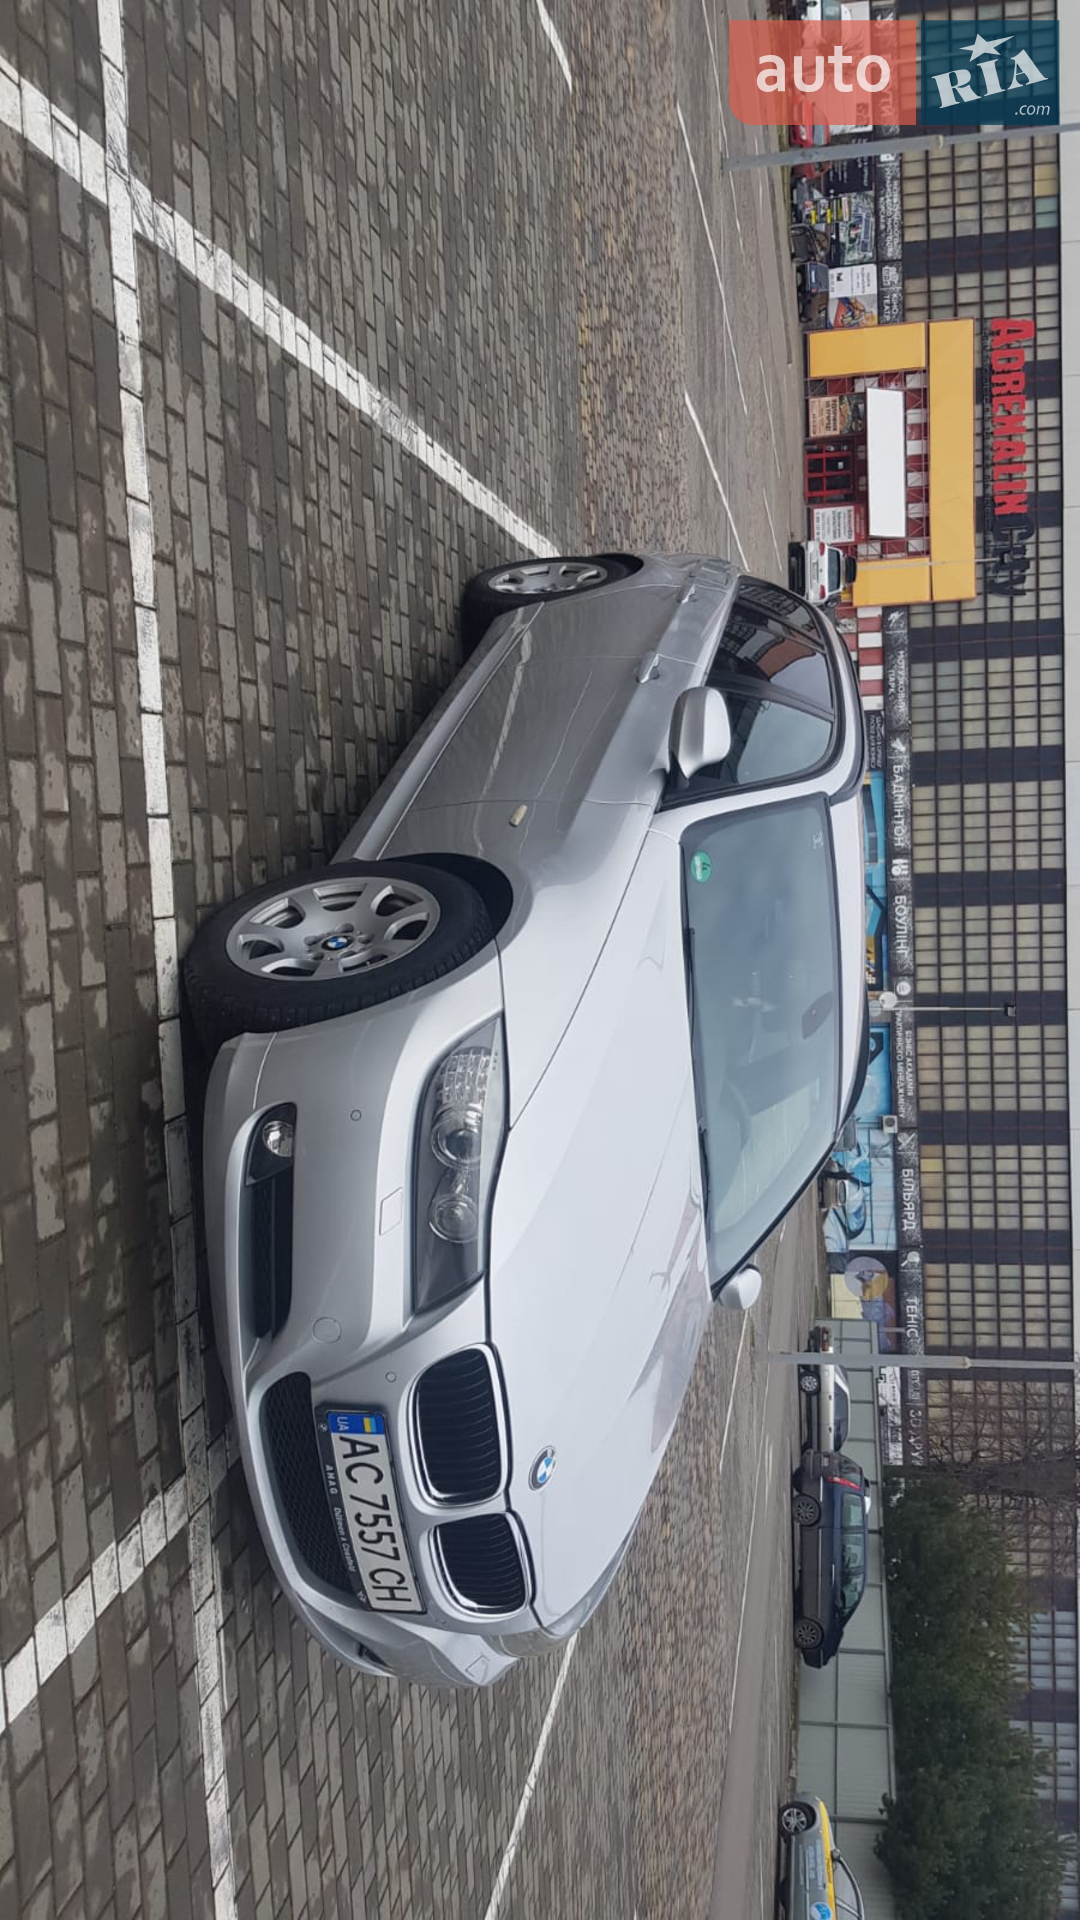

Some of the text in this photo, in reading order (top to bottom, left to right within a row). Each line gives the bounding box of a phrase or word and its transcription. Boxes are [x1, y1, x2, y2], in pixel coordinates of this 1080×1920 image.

[883, 294, 891, 320] ТЕАТР
[990, 318, 1035, 516] ADRENALIN
[888, 670, 896, 694] ПАРК
[892, 765, 905, 847] БАДМІНТОН
[894, 895, 908, 958] БОУЛІНГ
[897, 1062, 905, 1118] МЕНЕДЖМЕНТУ
[905, 1057, 914, 1096] АКАДЕМІЯ
[901, 1169, 915, 1231] БІЛЬЯРД
[906, 1297, 918, 1338] ТЕНІС
[336, 1416, 349, 1431] UA
[326, 1464, 338, 1494] AHAG
[339, 1436, 412, 1602] AC 7557 CH
